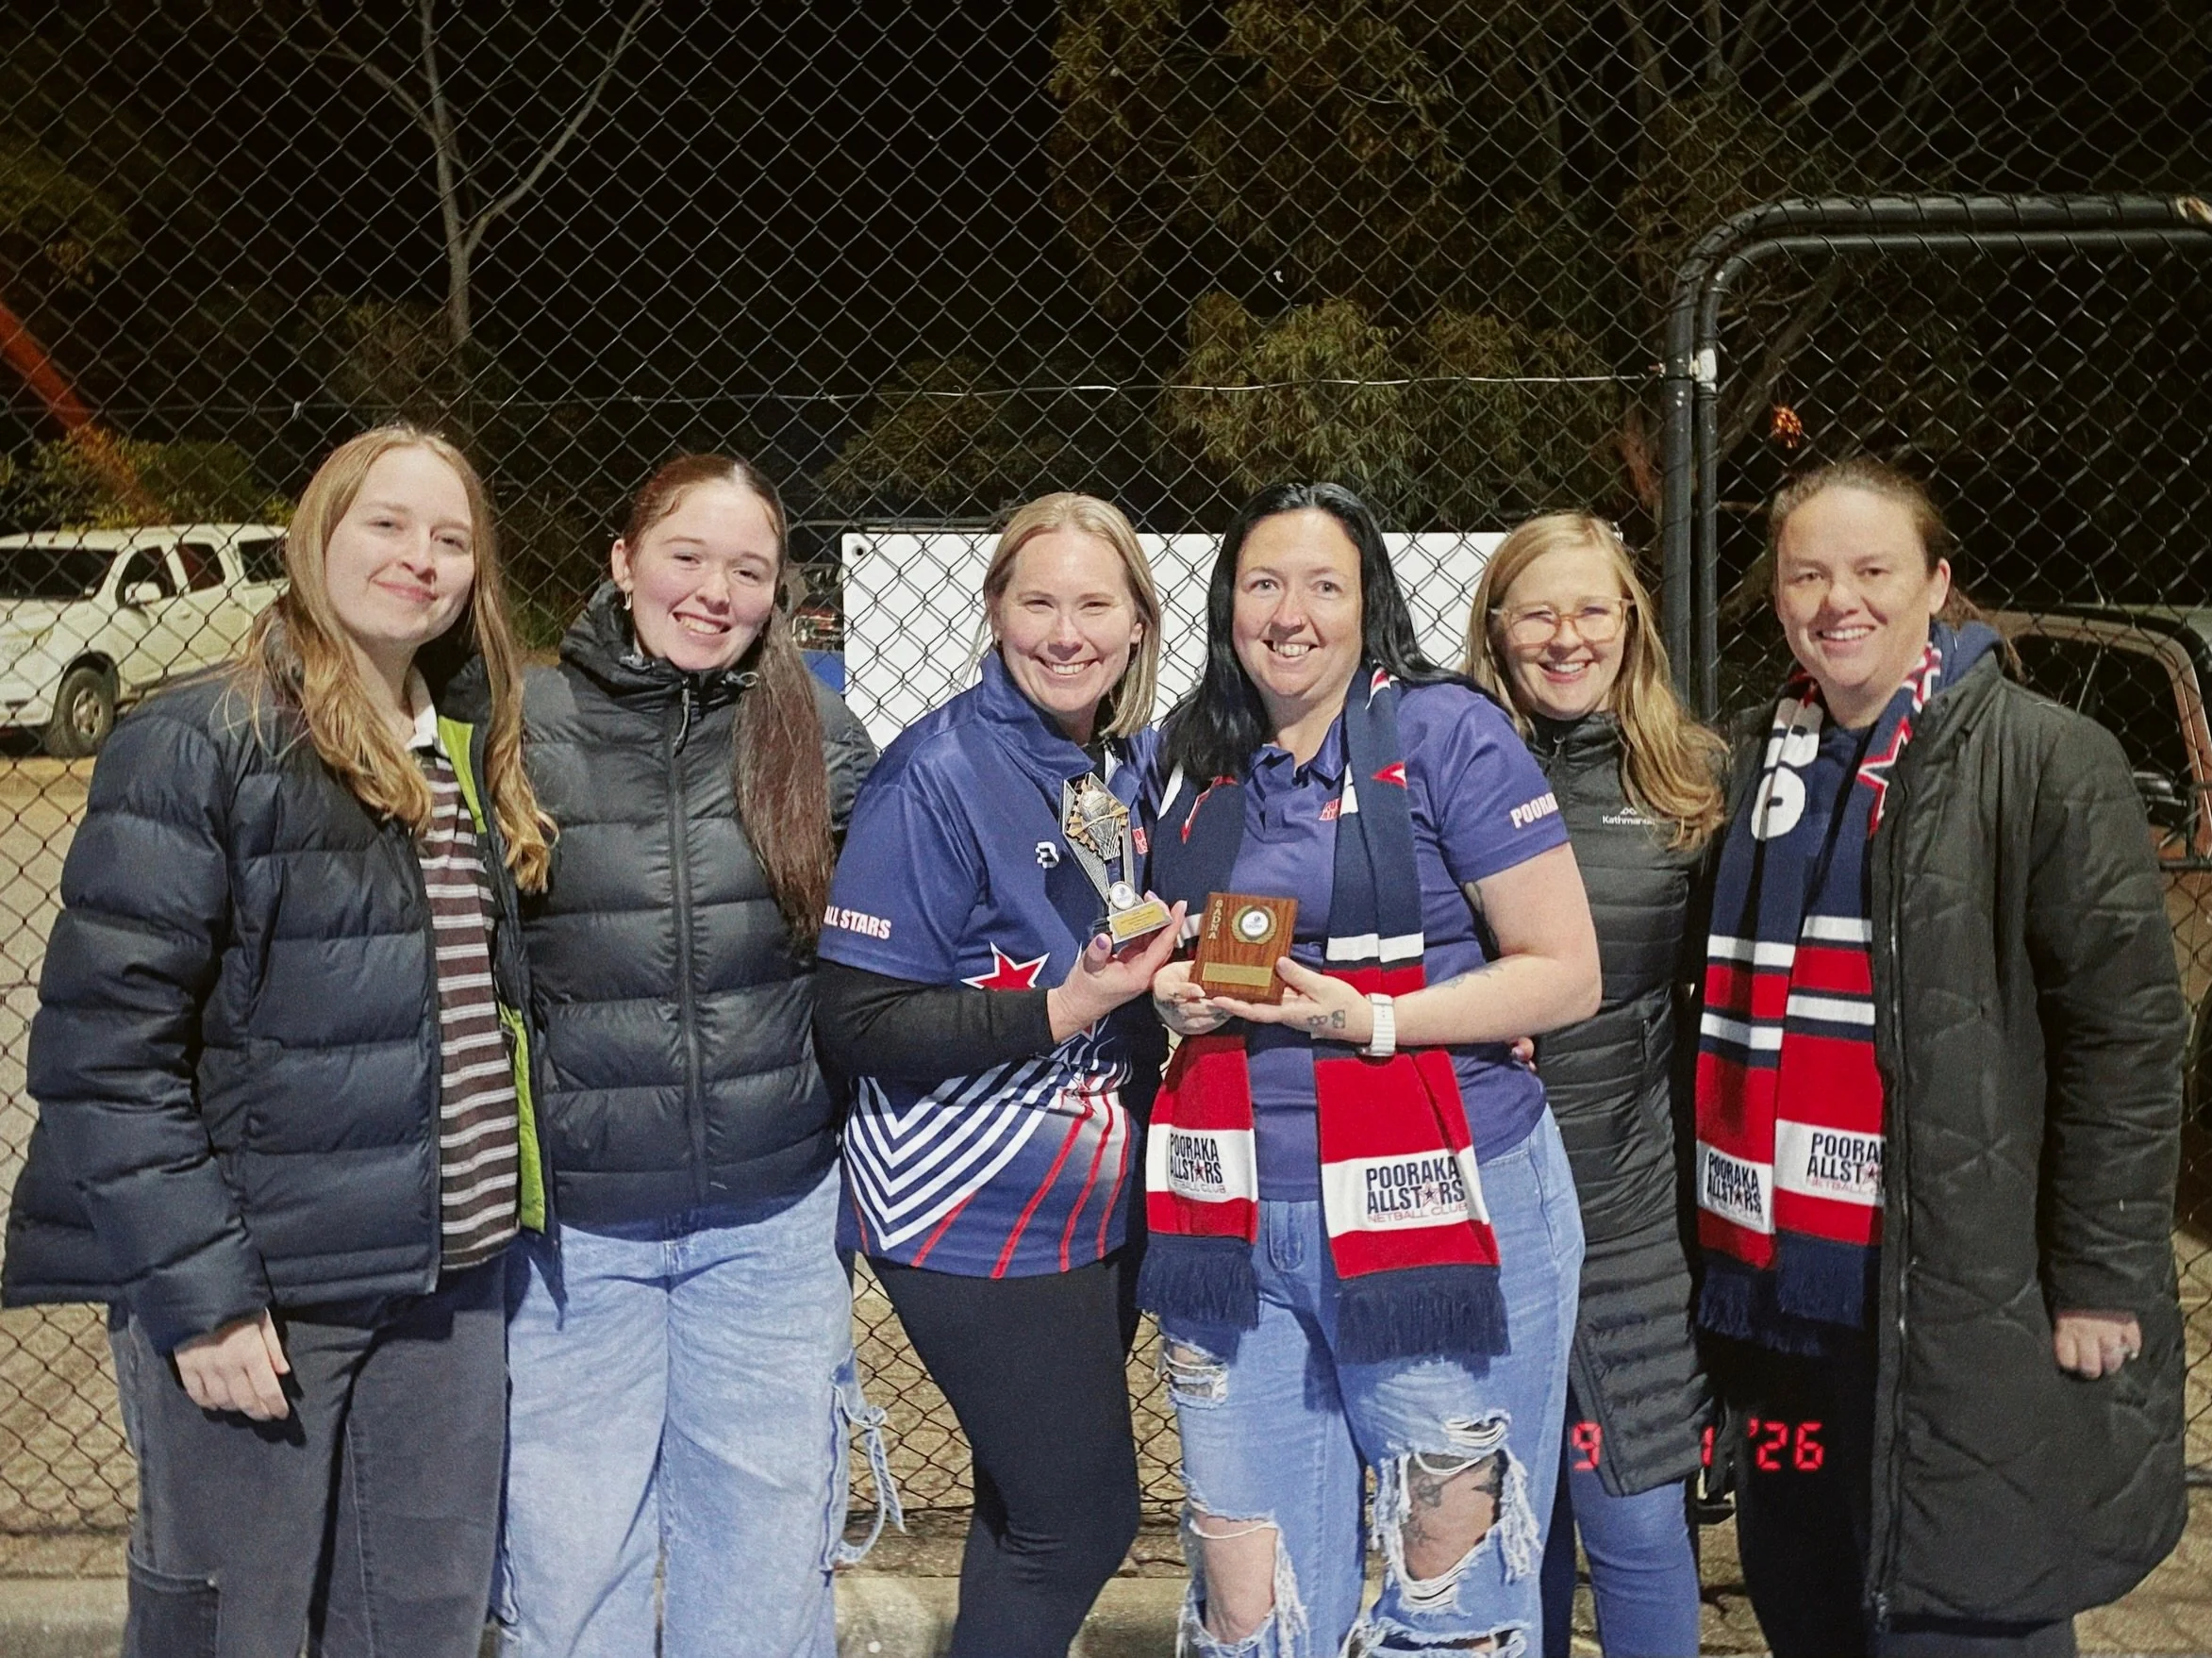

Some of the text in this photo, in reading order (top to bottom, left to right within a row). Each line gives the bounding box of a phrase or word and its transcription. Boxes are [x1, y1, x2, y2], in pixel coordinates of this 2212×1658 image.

[840, 908, 892, 940] STARS
[1207, 899, 1223, 940] SADNA
[1170, 1133, 1220, 1161] POORAKA
[1366, 1155, 1461, 1191] POORAKA
[1708, 1152, 1759, 1191] POORAKA
[1367, 1202, 1469, 1223] NETBALL CLUB
